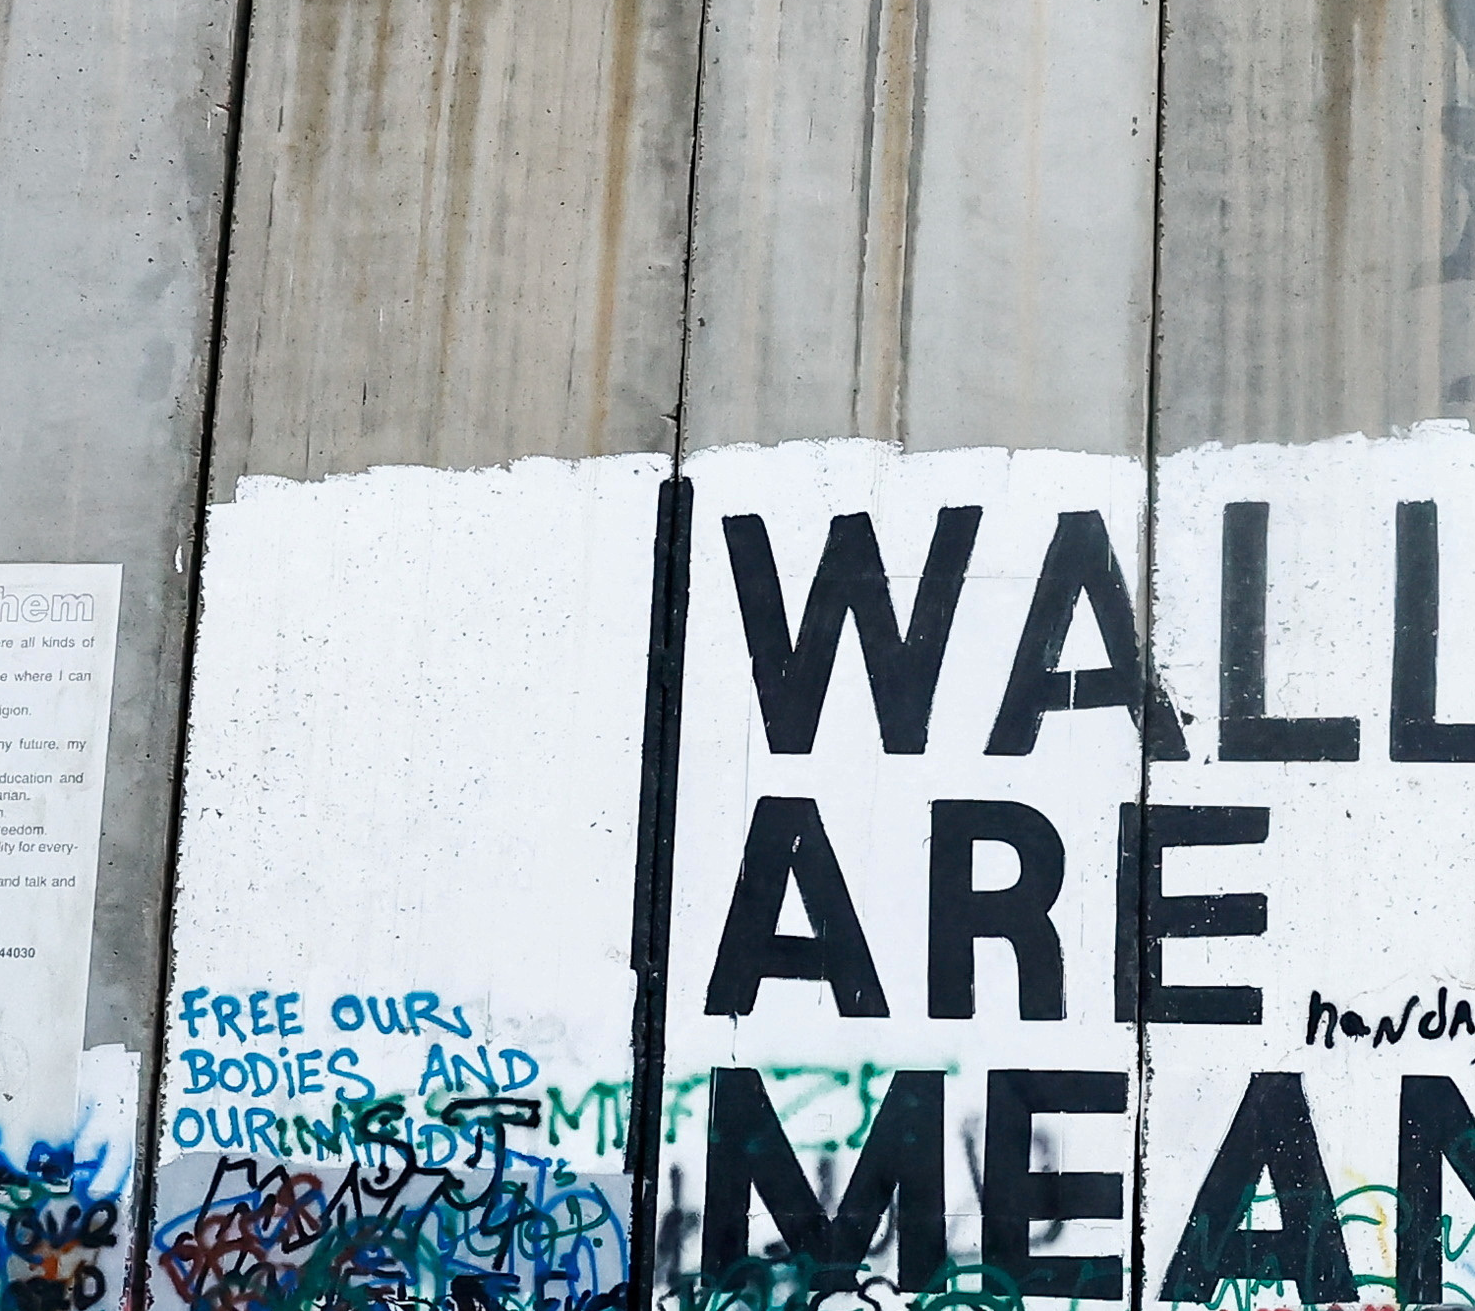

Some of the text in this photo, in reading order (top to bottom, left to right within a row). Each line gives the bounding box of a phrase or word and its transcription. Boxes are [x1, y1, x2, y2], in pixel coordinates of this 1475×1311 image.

[20, 636, 36, 649] all
[41, 635, 76, 649] kinds
[81, 635, 96, 649] of
[703, 797, 1271, 1023] ARE
[180, 987, 471, 1043] FREE OUR
[419, 1044, 539, 1095] AND
[173, 1107, 280, 1157] OUR
